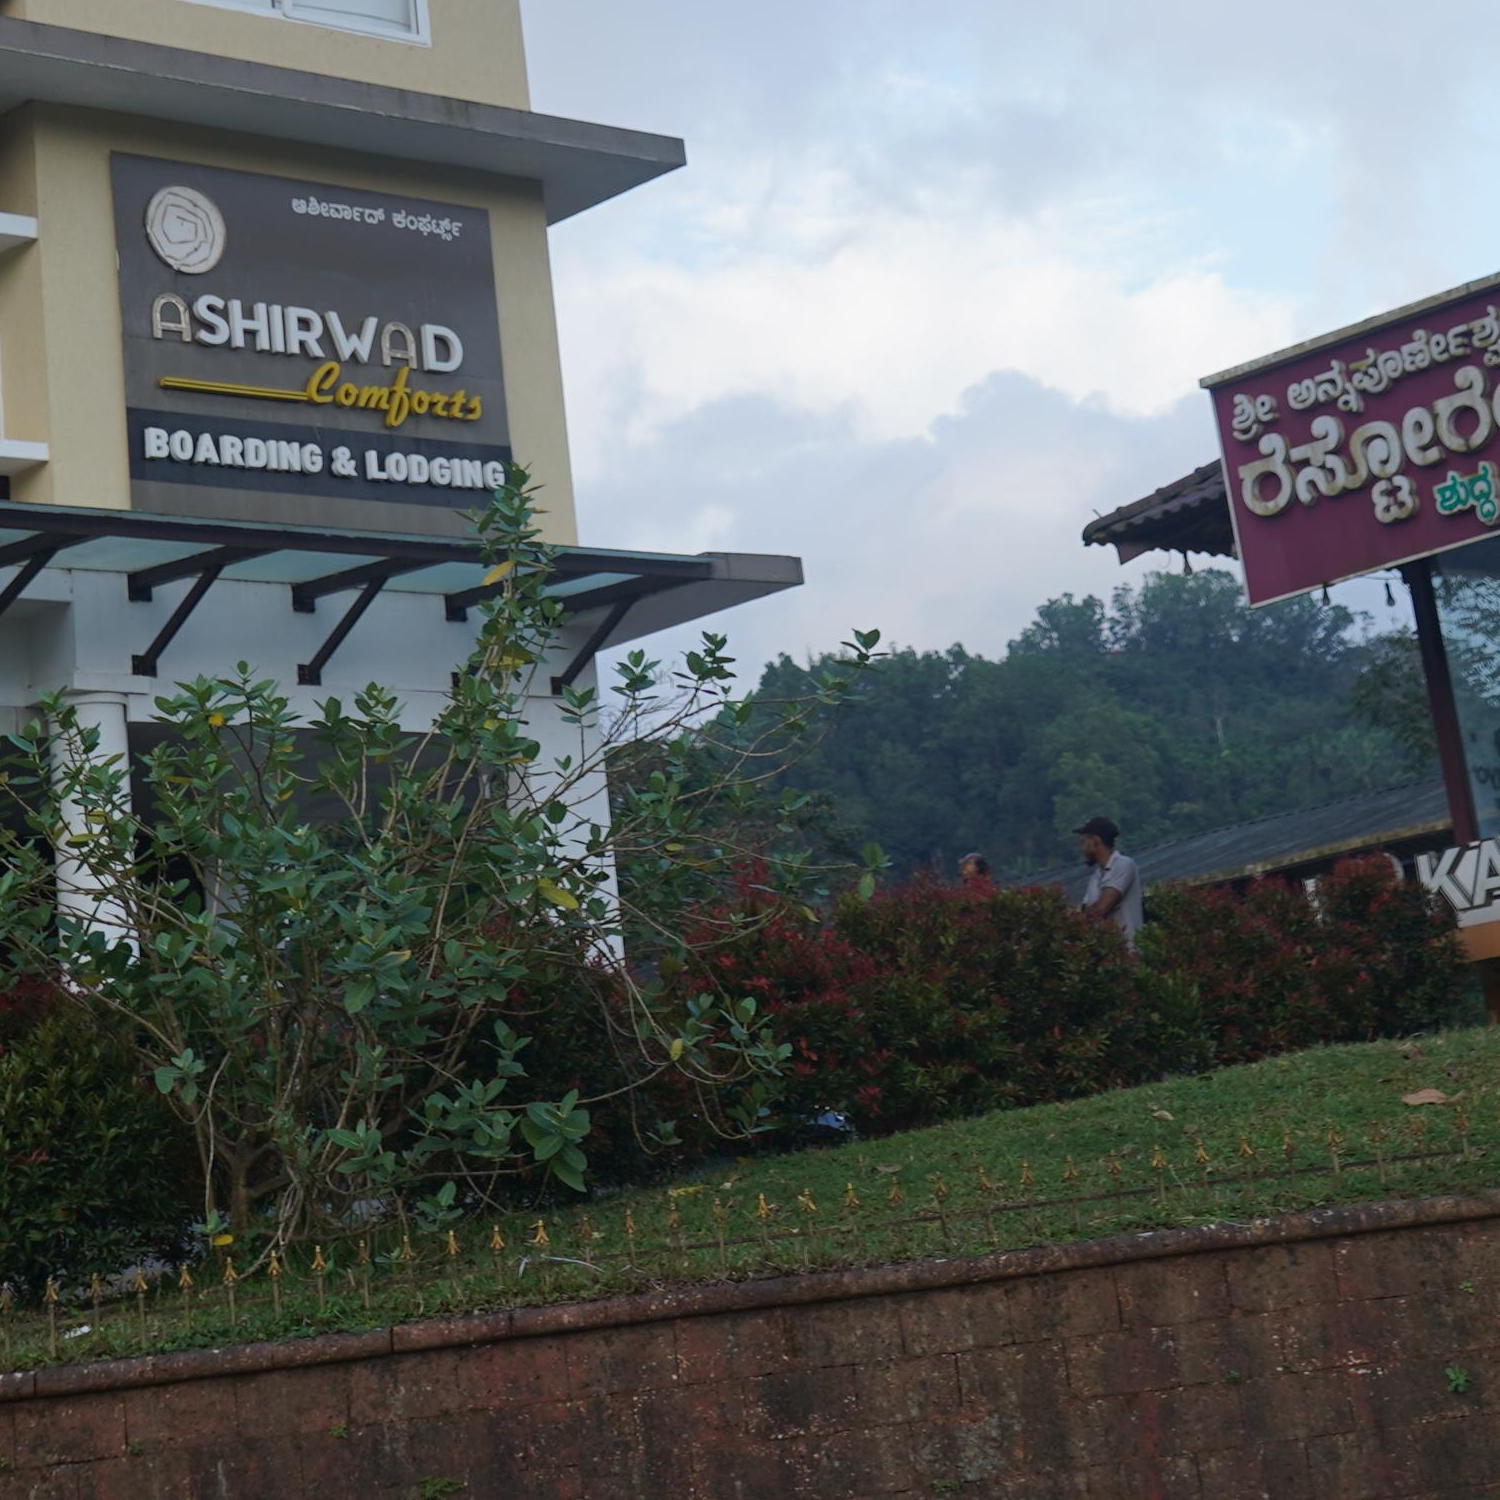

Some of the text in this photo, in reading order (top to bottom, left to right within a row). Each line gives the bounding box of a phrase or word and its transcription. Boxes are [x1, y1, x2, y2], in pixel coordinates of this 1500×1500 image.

[292, 196, 385, 225] ಆಶೀರ್ವಾದ್
[152, 293, 464, 373] ASHIRWAD
[307, 360, 482, 427] Comforts
[1231, 393, 1279, 443] ಶ್ರೀ
[144, 426, 505, 490] BOARDING & LODGING
